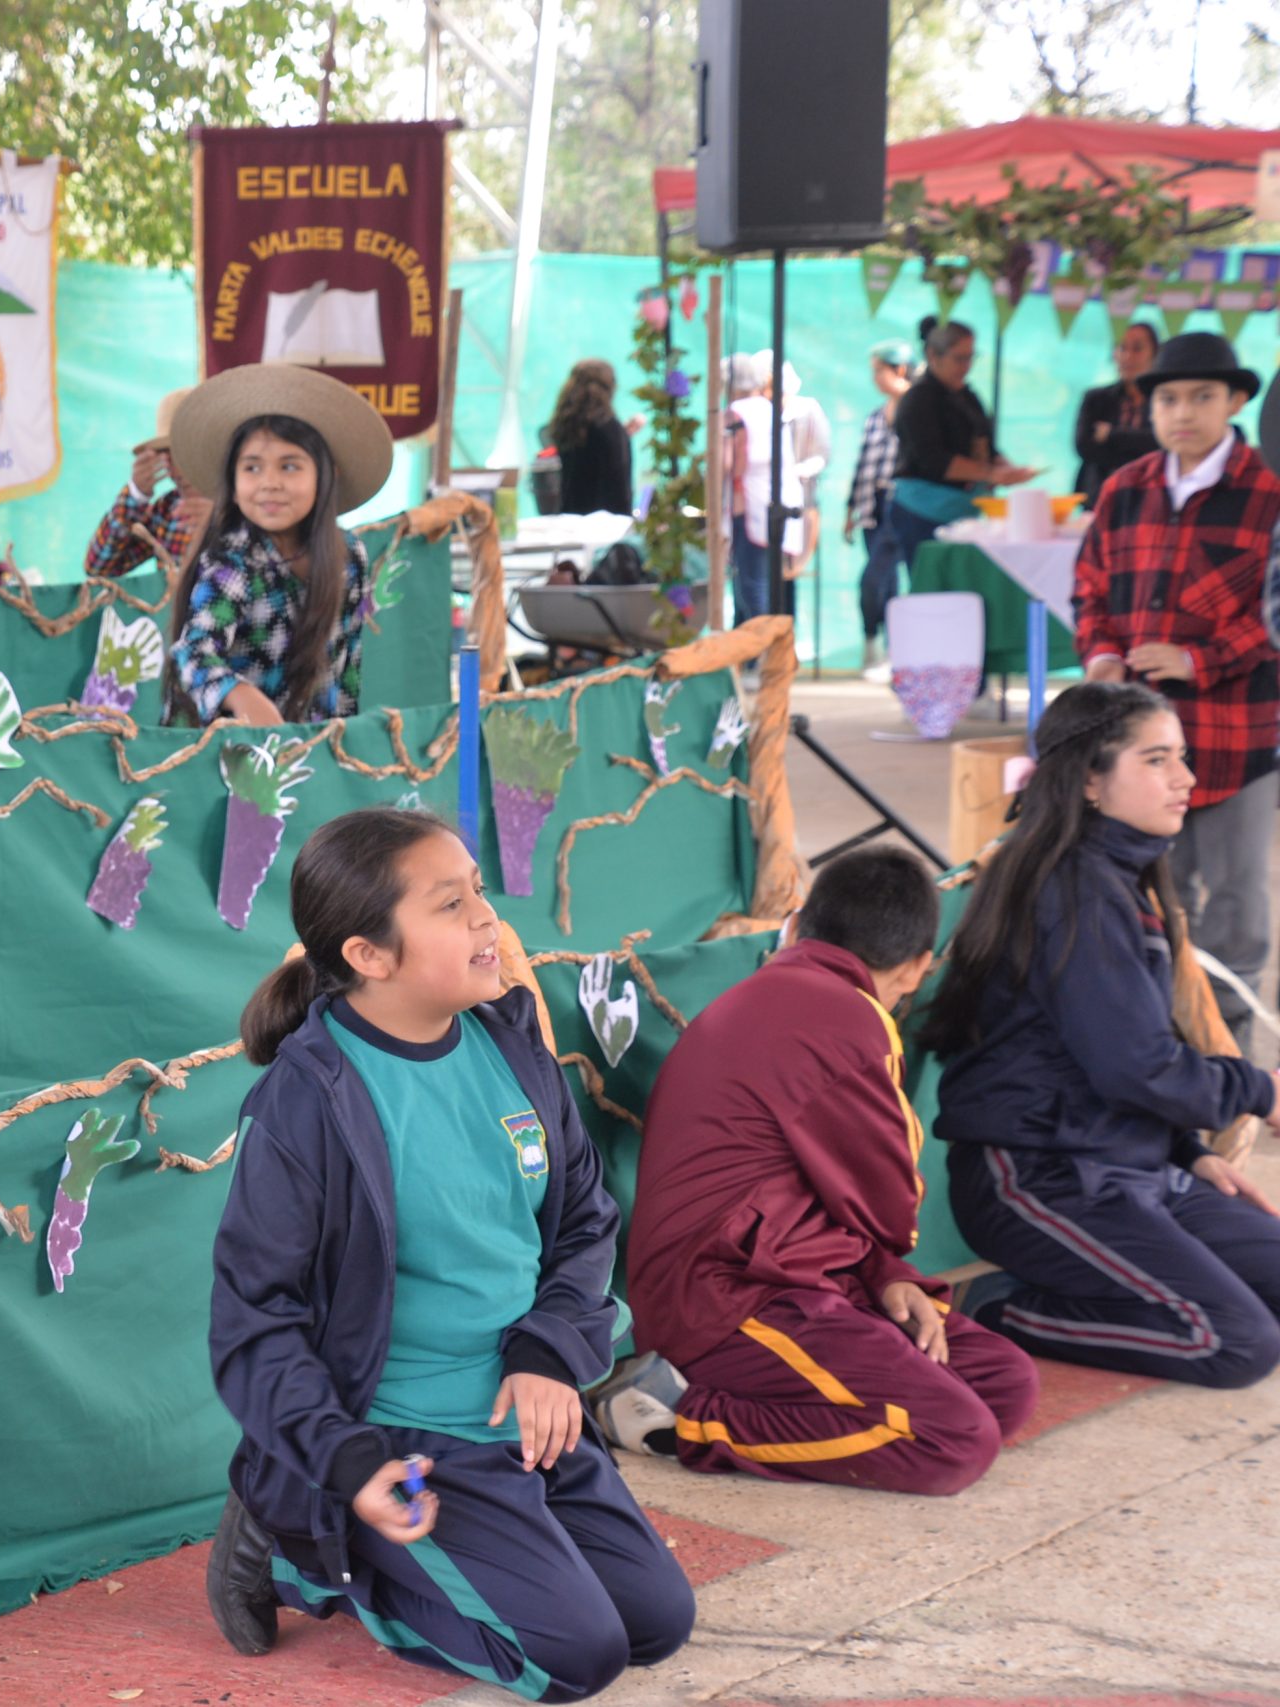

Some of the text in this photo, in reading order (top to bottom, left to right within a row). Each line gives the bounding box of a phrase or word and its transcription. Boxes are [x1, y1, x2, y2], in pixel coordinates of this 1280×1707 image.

[236, 163, 408, 200] ESCUELA
[212, 227, 433, 341] MARTA VALDES ECHENIQUE
